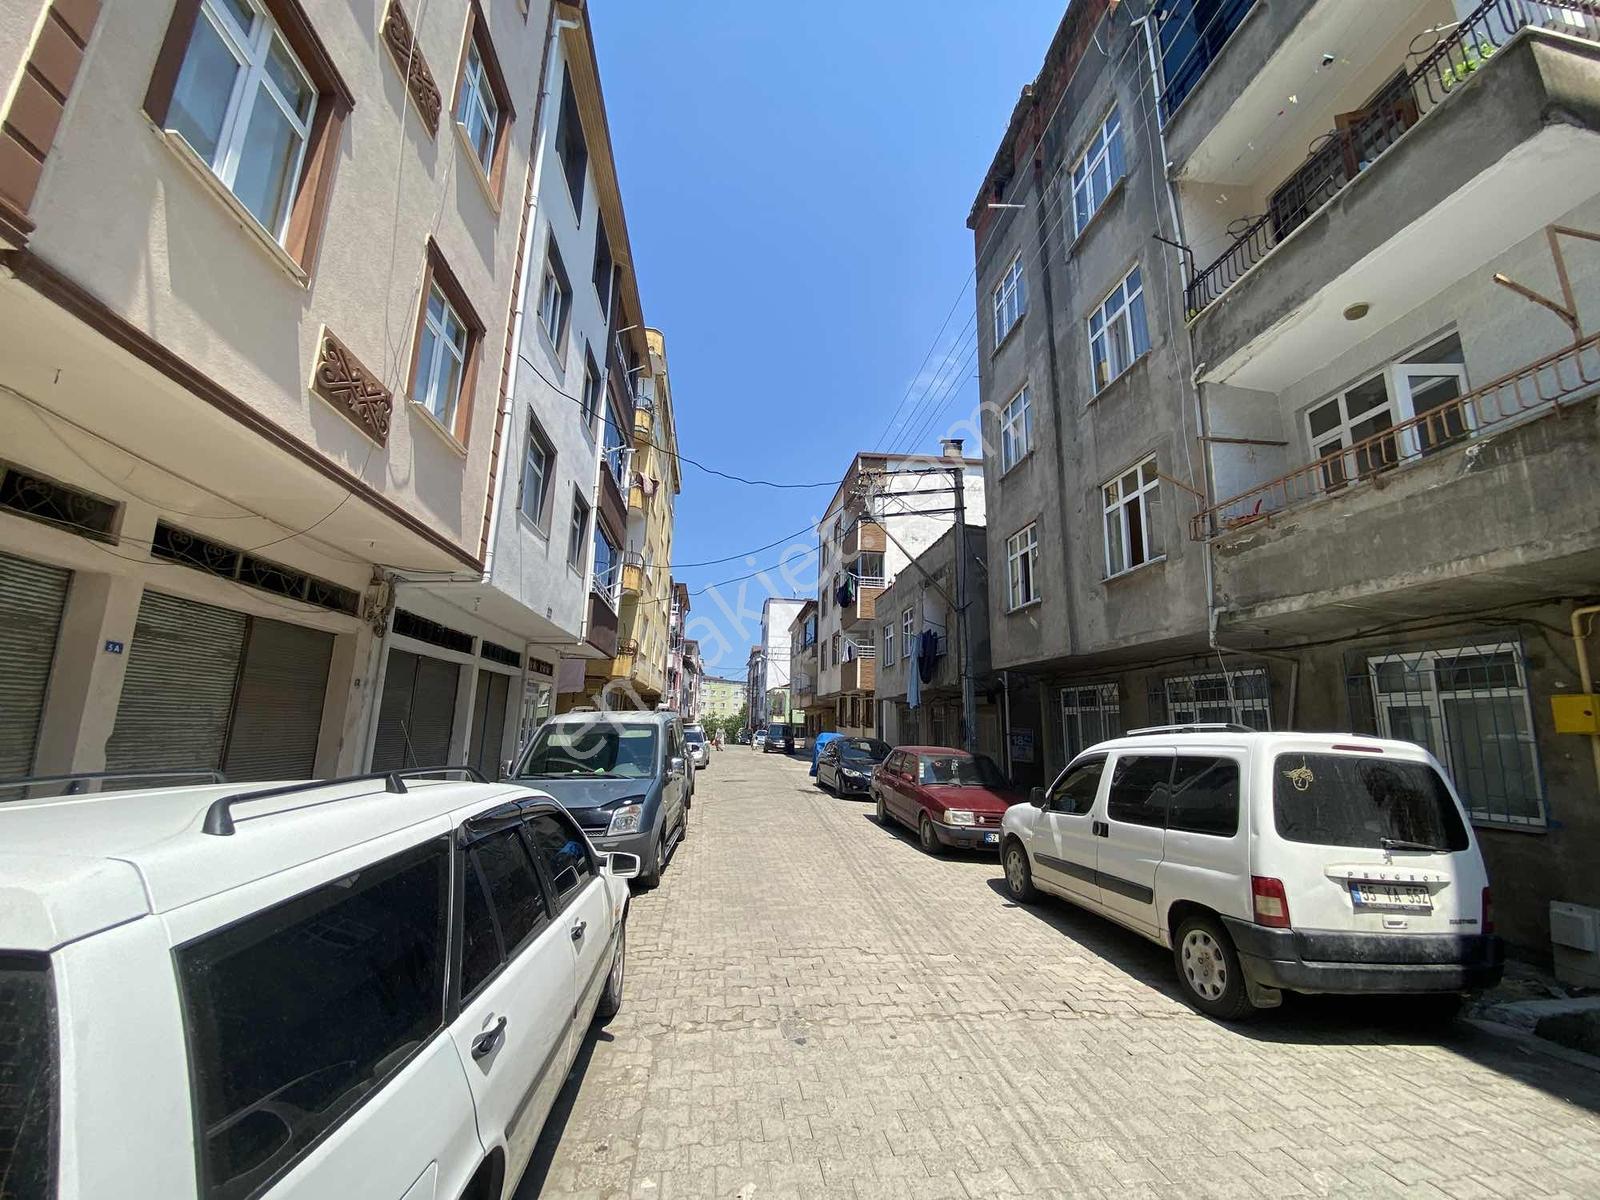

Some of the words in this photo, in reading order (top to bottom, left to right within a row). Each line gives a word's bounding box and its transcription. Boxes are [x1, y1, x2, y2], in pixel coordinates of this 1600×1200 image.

[1347, 871, 1440, 881] PEUGEOT
[1361, 885, 1377, 901] 55
[1384, 886, 1402, 903] YA
[1406, 888, 1429, 904] 552
